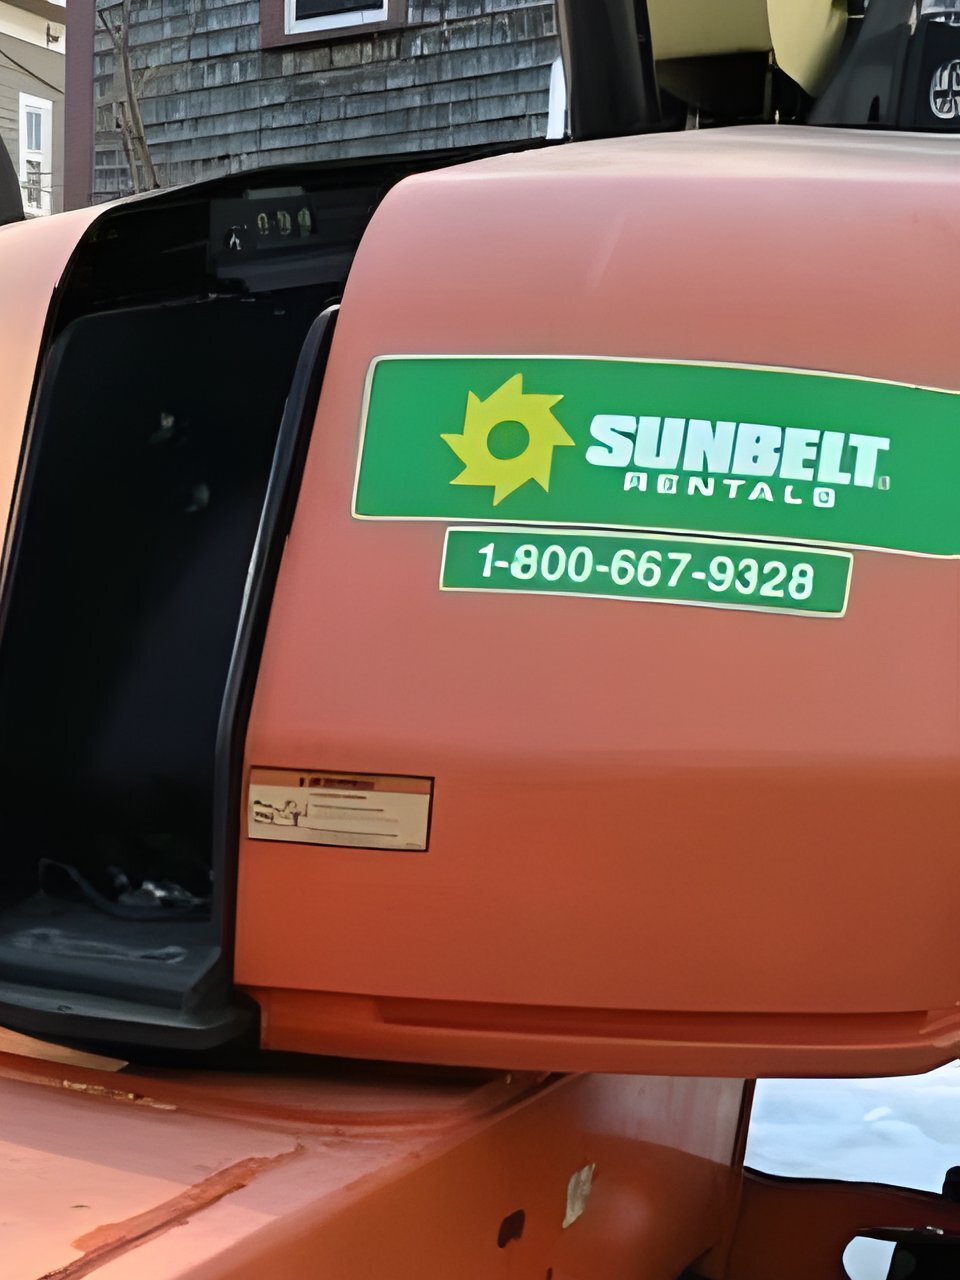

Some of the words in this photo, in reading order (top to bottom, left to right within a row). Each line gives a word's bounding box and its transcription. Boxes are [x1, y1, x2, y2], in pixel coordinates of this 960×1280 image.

[585, 414, 890, 488] SUNBELT
[623, 471, 836, 508] RNTAL
[478, 542, 815, 600] 1-800-667-9328
